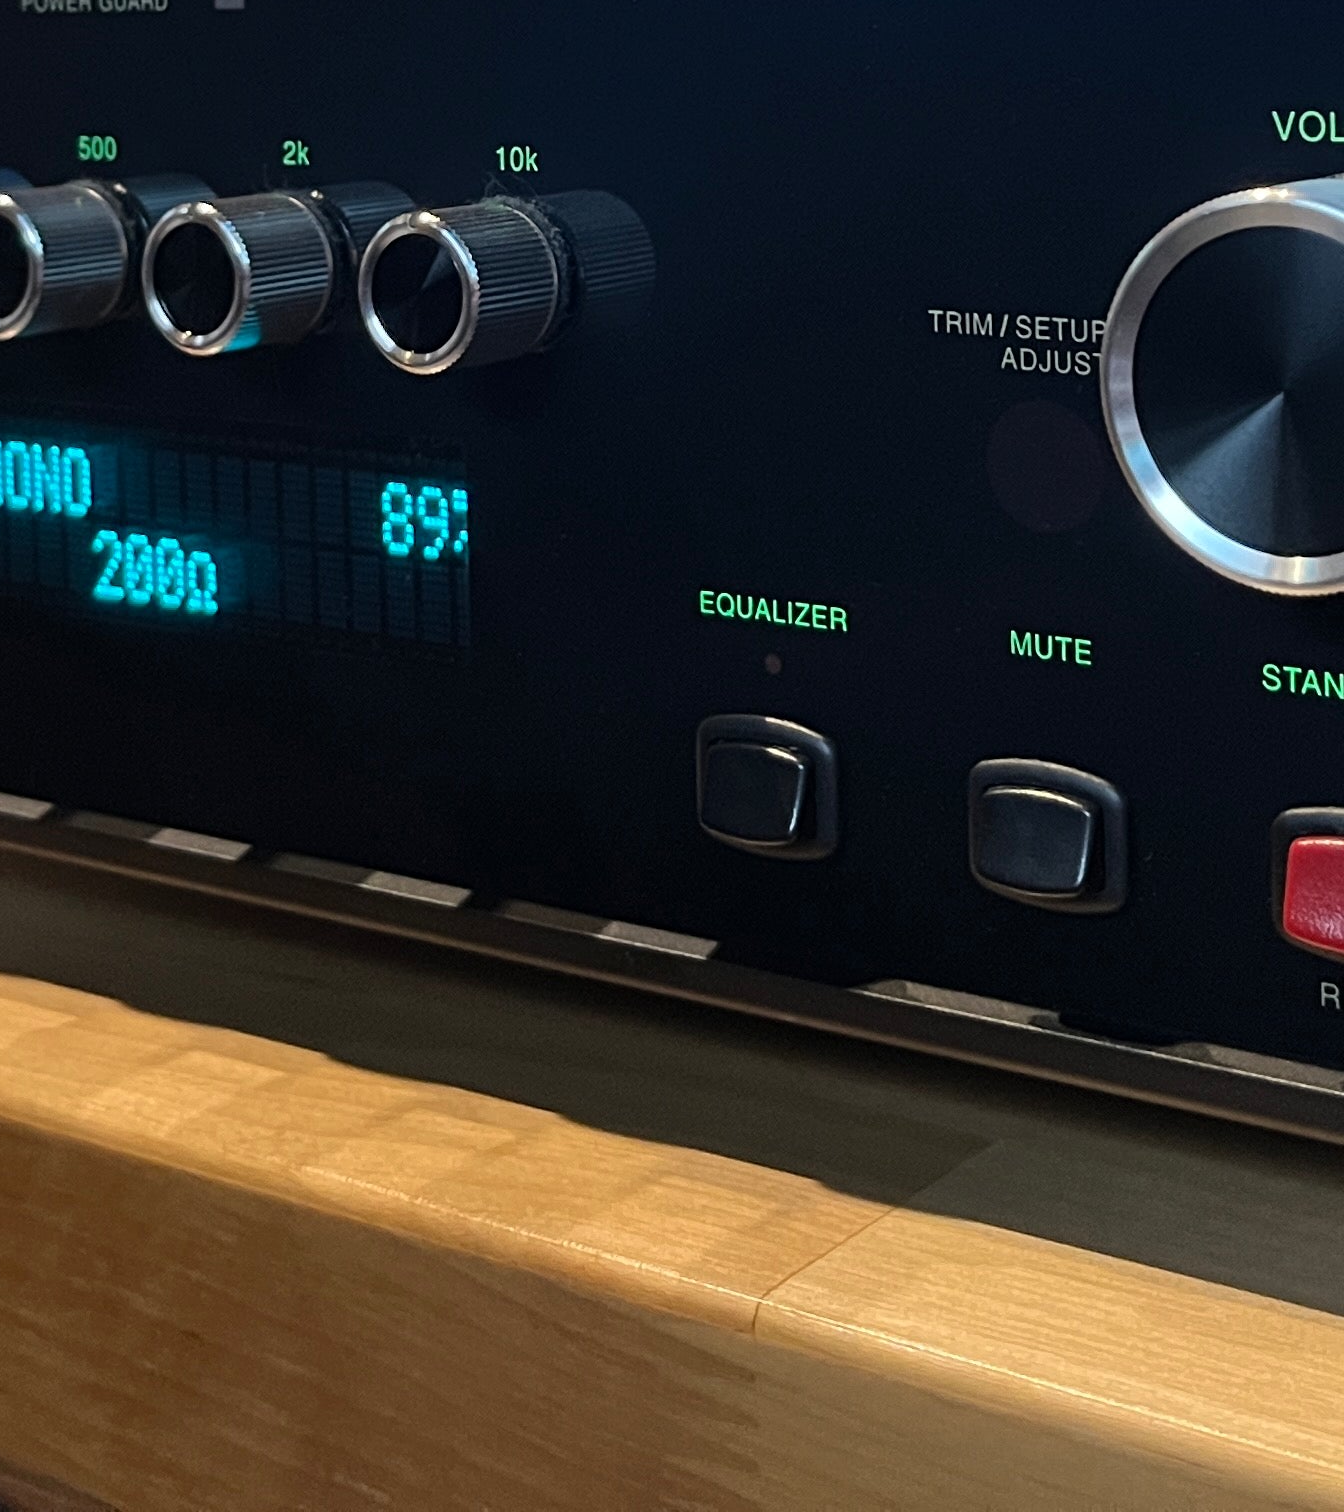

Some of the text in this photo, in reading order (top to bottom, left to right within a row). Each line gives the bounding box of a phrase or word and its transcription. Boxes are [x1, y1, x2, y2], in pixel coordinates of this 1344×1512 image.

[77, 135, 118, 162] 500
[282, 140, 310, 166] 2k
[494, 145, 539, 172] 10k
[927, 309, 993, 337] TRIM
[1015, 314, 1107, 343] SETUP
[699, 590, 848, 632] EQUALIZER
[1010, 629, 1093, 666] MUTE
